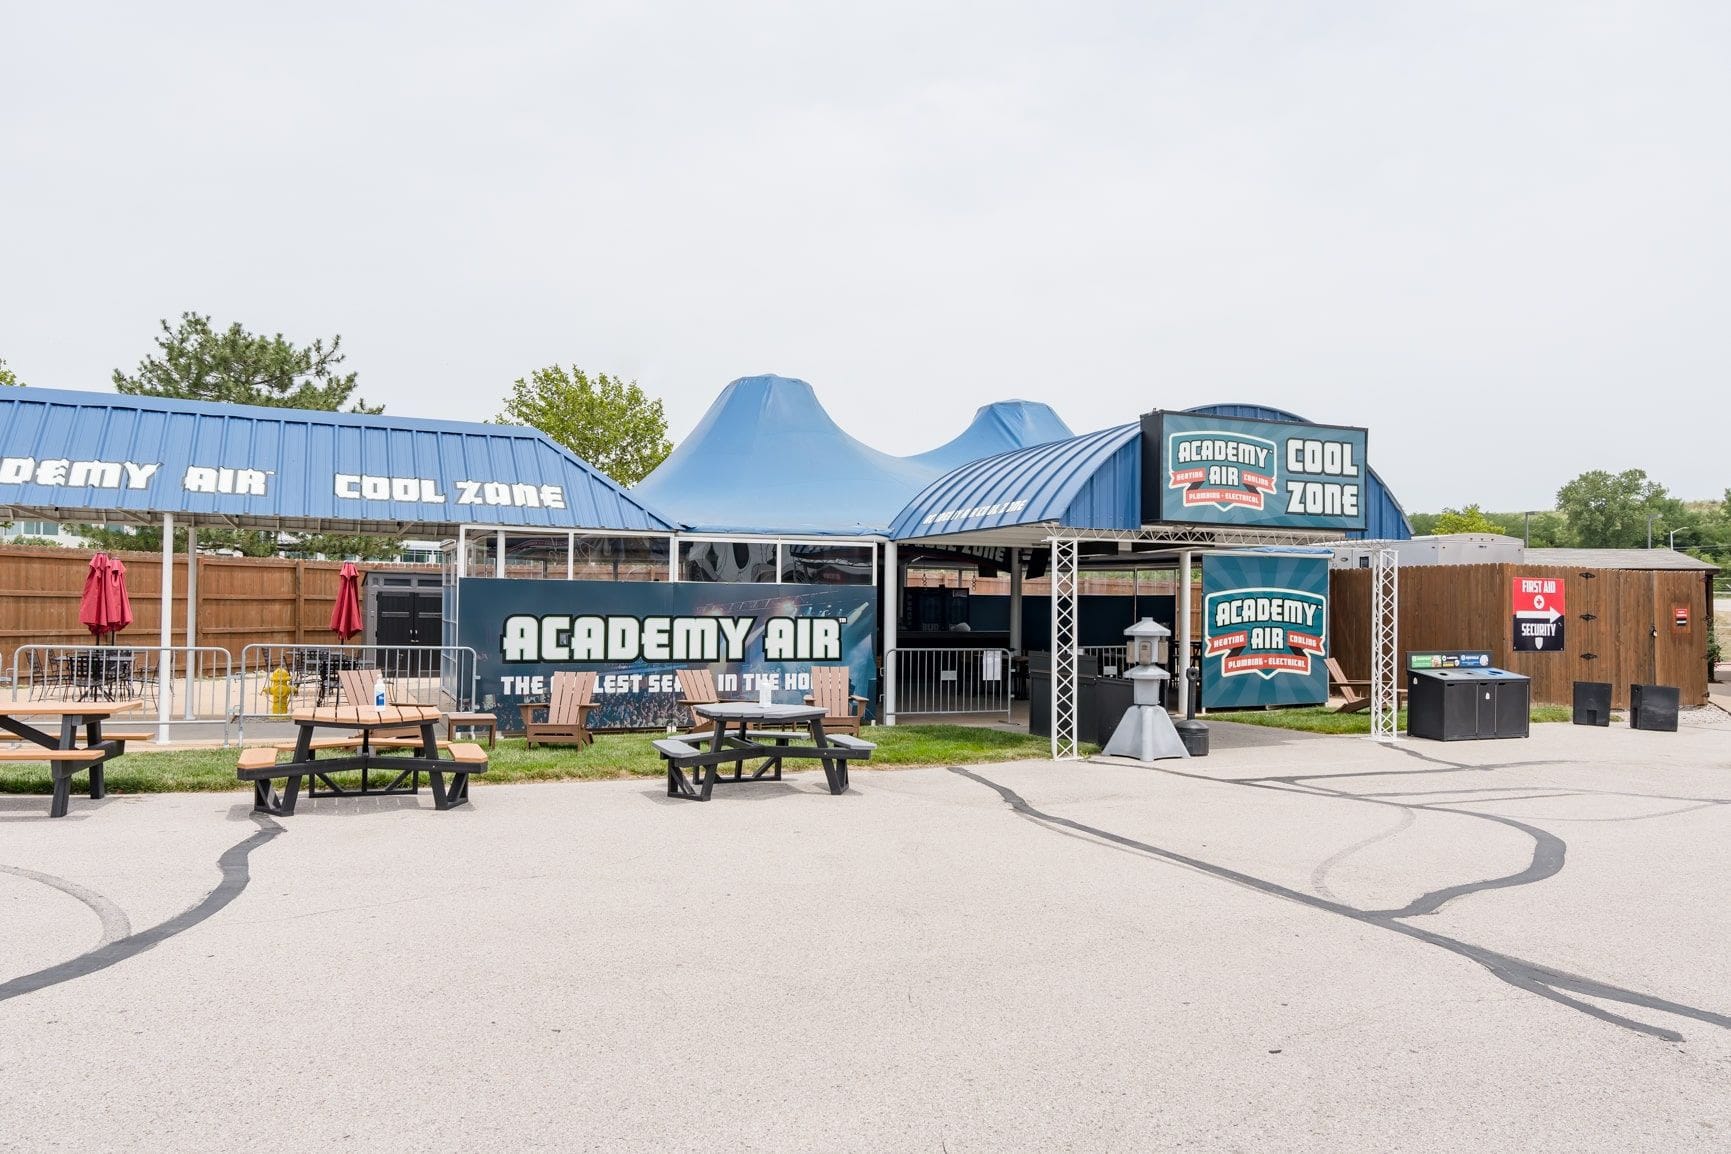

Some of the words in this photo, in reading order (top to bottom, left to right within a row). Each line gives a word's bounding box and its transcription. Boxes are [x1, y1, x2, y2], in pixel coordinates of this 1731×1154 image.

[1178, 439, 1270, 469] ACADEMY
[1286, 437, 1359, 478] COOL
[1176, 470, 1204, 481] HEATING
[1208, 465, 1240, 487] AIR
[1243, 474, 1269, 487] COOLING
[334, 473, 445, 504] COOL
[455, 480, 567, 509] ZONE
[1224, 493, 1260, 504] ELECTRICAL
[1285, 480, 1359, 518] ZONE
[1521, 580, 1543, 593] FIRST
[1543, 581, 1557, 594] AID
[1215, 598, 1317, 628] ACADEMY
[501, 614, 757, 663] ACADEMY
[1213, 634, 1245, 648] HEATING
[1250, 627, 1285, 650] AIR
[1289, 634, 1317, 647] COOLING
[1521, 623, 1557, 637] SECURITY
[1228, 657, 1264, 669] PLUMBING
[1267, 657, 1306, 668] ELECTRICAL
[501, 676, 544, 695] THE
[718, 674, 738, 692] IN
[743, 673, 780, 691] THE
